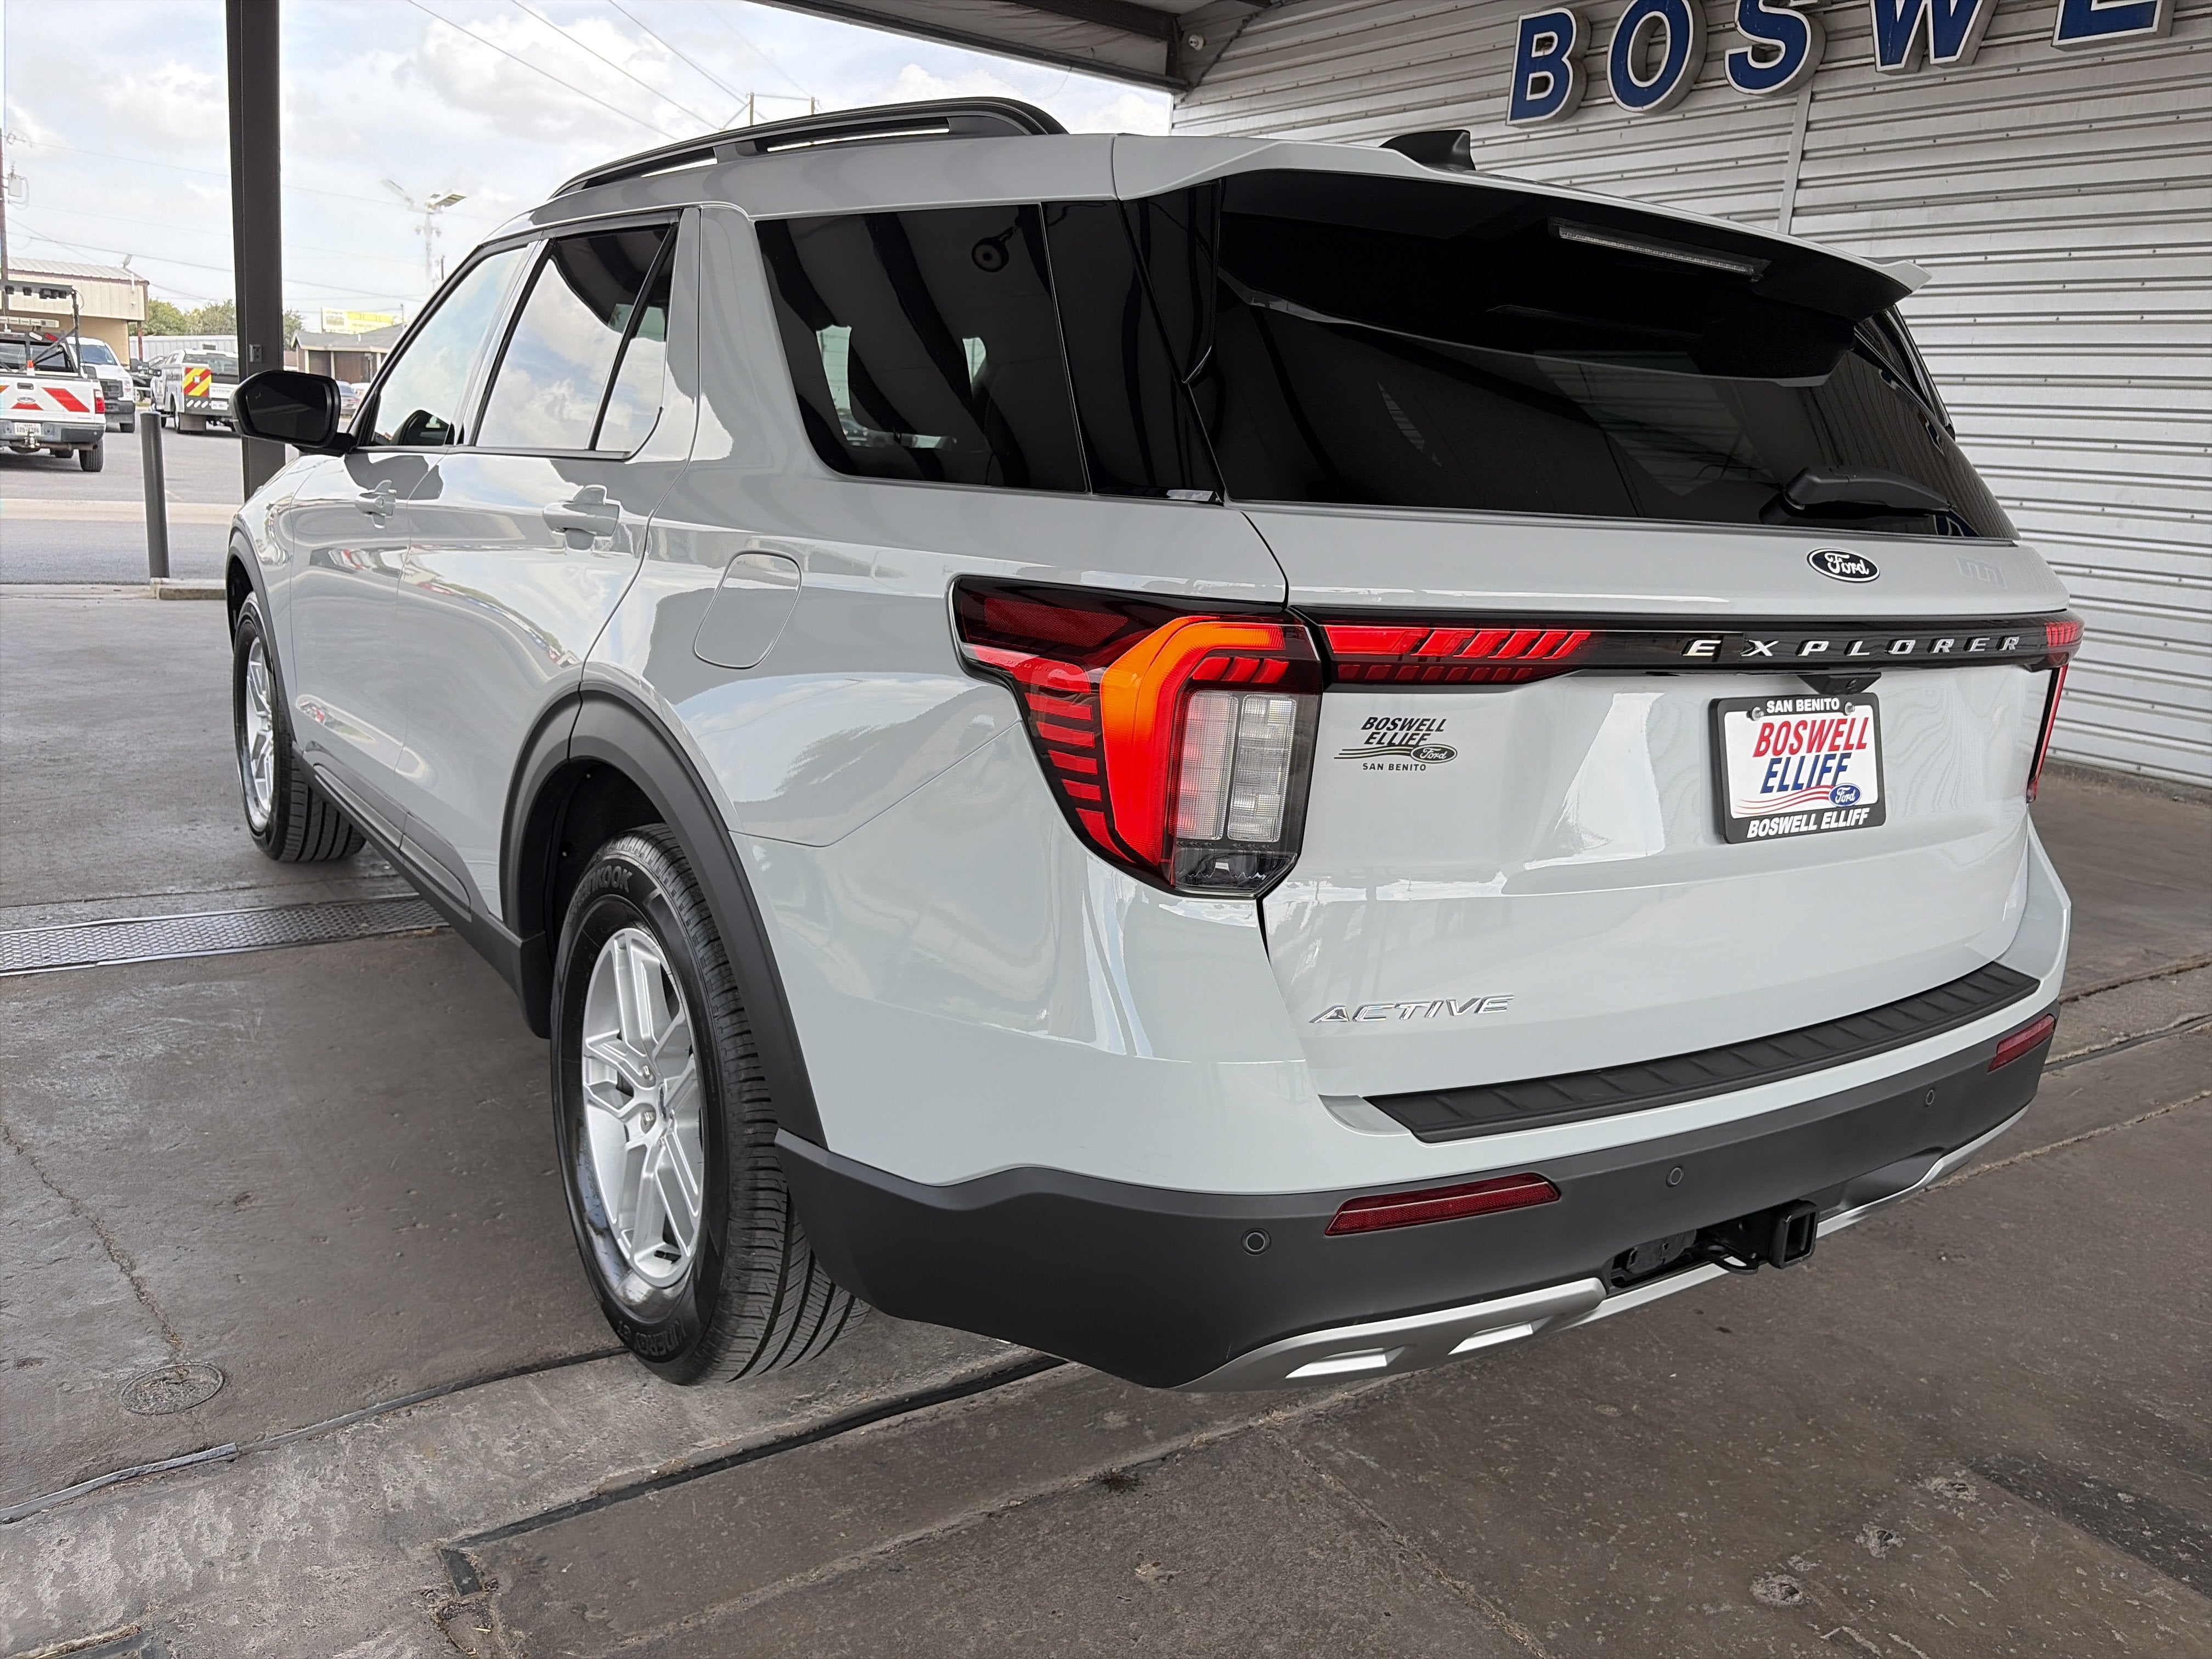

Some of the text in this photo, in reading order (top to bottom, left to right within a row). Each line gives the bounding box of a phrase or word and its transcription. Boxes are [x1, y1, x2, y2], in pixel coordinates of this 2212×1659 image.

[1824, 552, 1870, 574] Ford
[1682, 636, 2021, 657] EXPLORER
[1766, 698, 1839, 713] SAN BENITO
[1361, 716, 1447, 732] BOSWELL
[1363, 732, 1431, 746] ELLIFF
[1752, 717, 1869, 758] BOSWELL
[1420, 747, 1447, 759] Ford
[1388, 763, 1426, 771] BENITO
[1760, 752, 1852, 794] ELLIFF
[1835, 786, 1856, 803] Ford
[1746, 808, 1870, 838] BOSWELL ELLIFF
[1309, 995, 1515, 1024] ACTIVE
